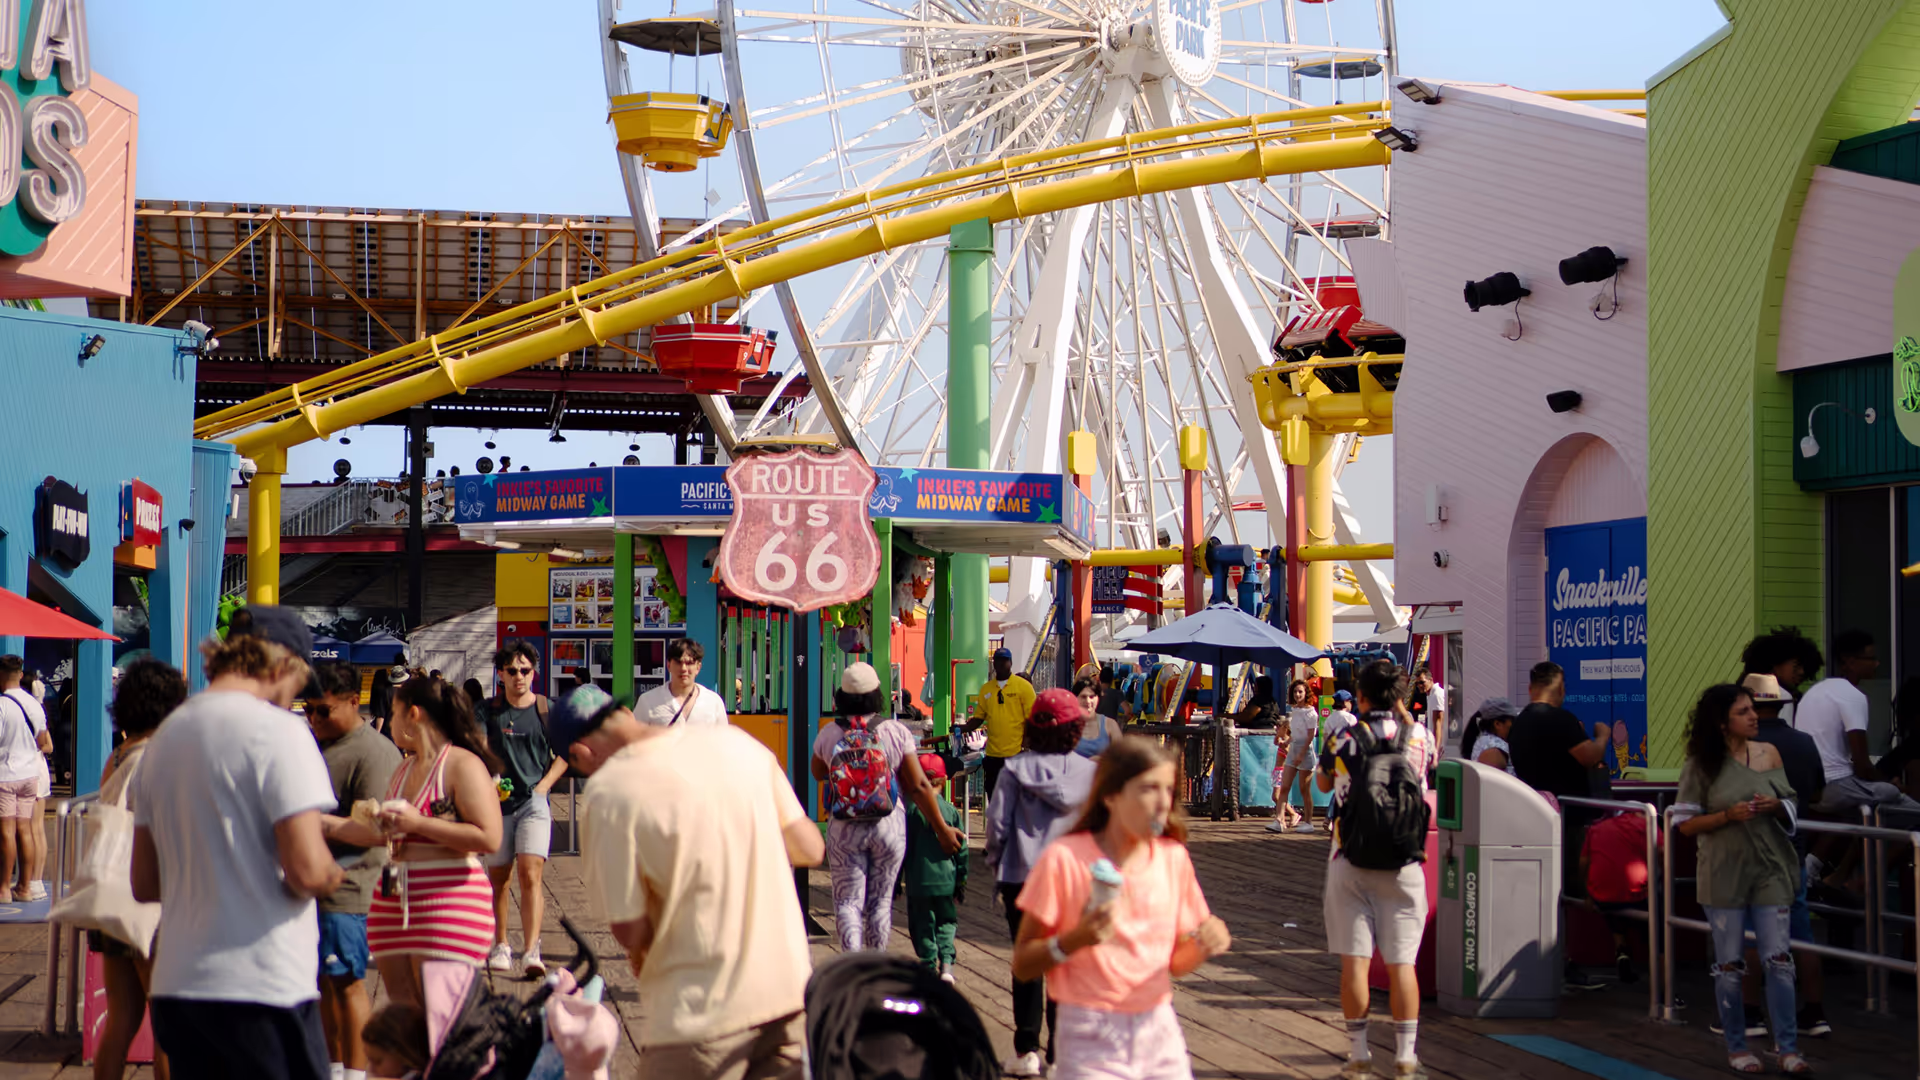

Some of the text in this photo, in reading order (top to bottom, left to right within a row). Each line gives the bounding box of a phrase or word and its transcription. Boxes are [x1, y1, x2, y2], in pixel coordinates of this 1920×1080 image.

[1175, 20, 1205, 60] PARK
[497, 477, 603, 497] INKIE'S FAVORITE
[752, 464, 851, 494] ROUTE
[917, 478, 1052, 498] INKIE'S FAVORITE
[681, 482, 727, 499] PACIFIC
[496, 493, 586, 512] MIDWAY GAME
[703, 502, 726, 510] SANTA
[917, 493, 1031, 513] MIDWAY GAME
[136, 496, 160, 534] PRIZES
[754, 530, 849, 592] 66
[1553, 566, 1648, 611] Snackville
[1553, 614, 1648, 648] PACIFIC PA
[312, 648, 339, 658] zels
[1613, 664, 1641, 673] DELICIOUS
[1465, 872, 1477, 972] COMPOST ONLY
